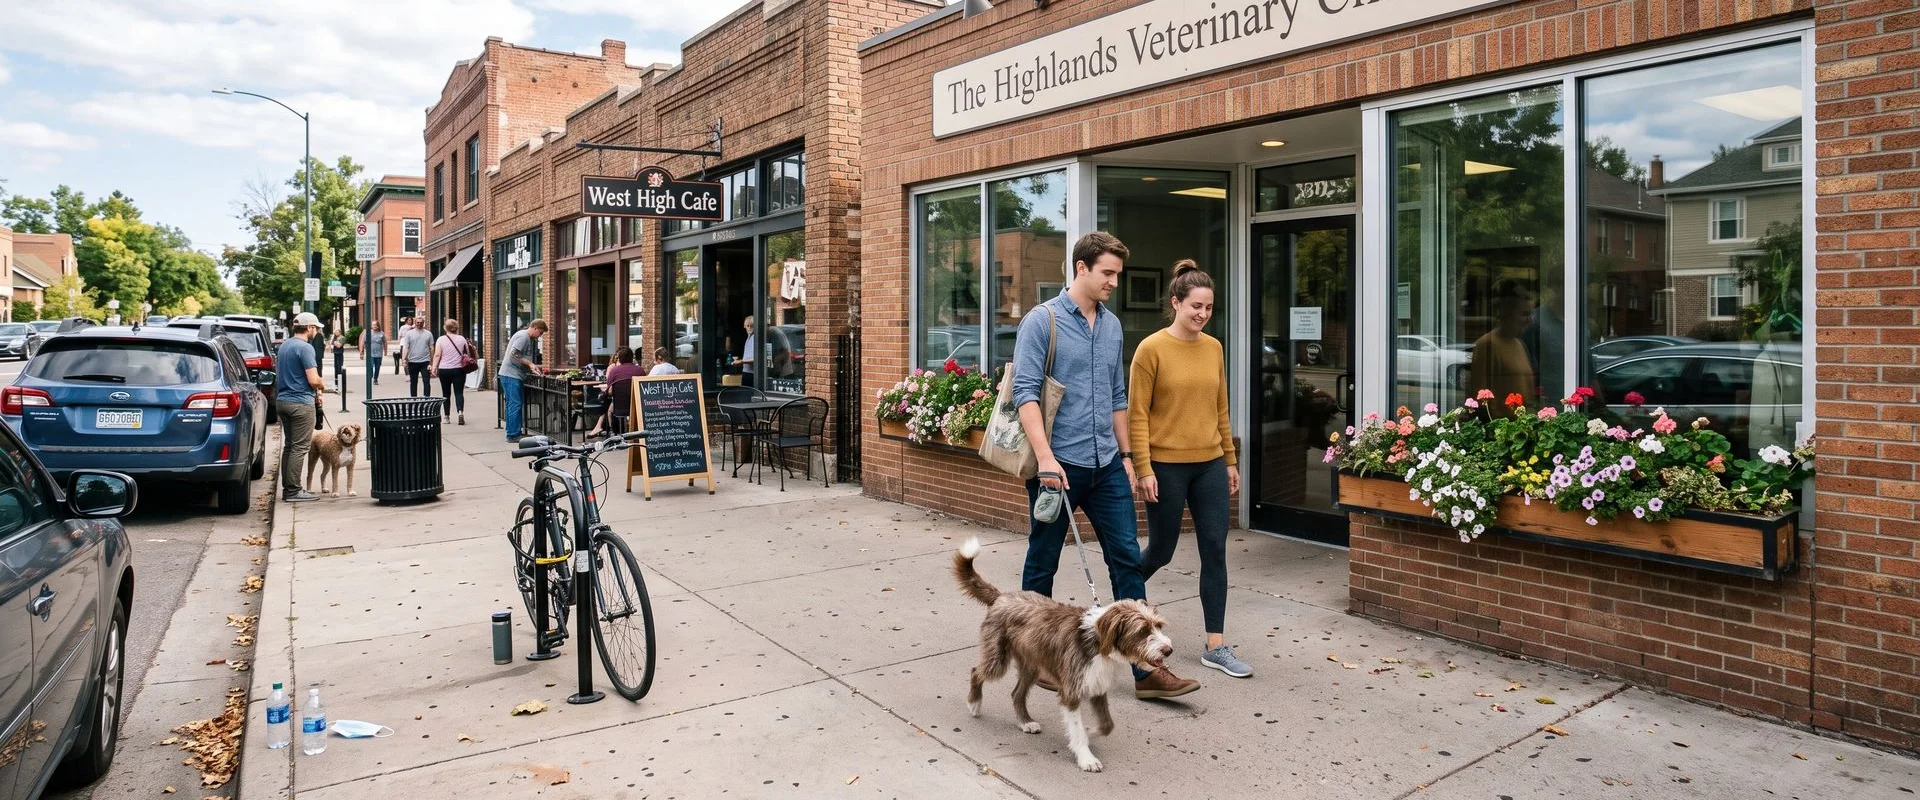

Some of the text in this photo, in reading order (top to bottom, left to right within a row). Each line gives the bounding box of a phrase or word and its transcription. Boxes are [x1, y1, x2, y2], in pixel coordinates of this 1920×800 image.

[948, 0, 1299, 114] The Highlands Veterinary
[588, 186, 717, 214] West High Cafe
[640, 382, 660, 395] West
[662, 382, 678, 398] High
